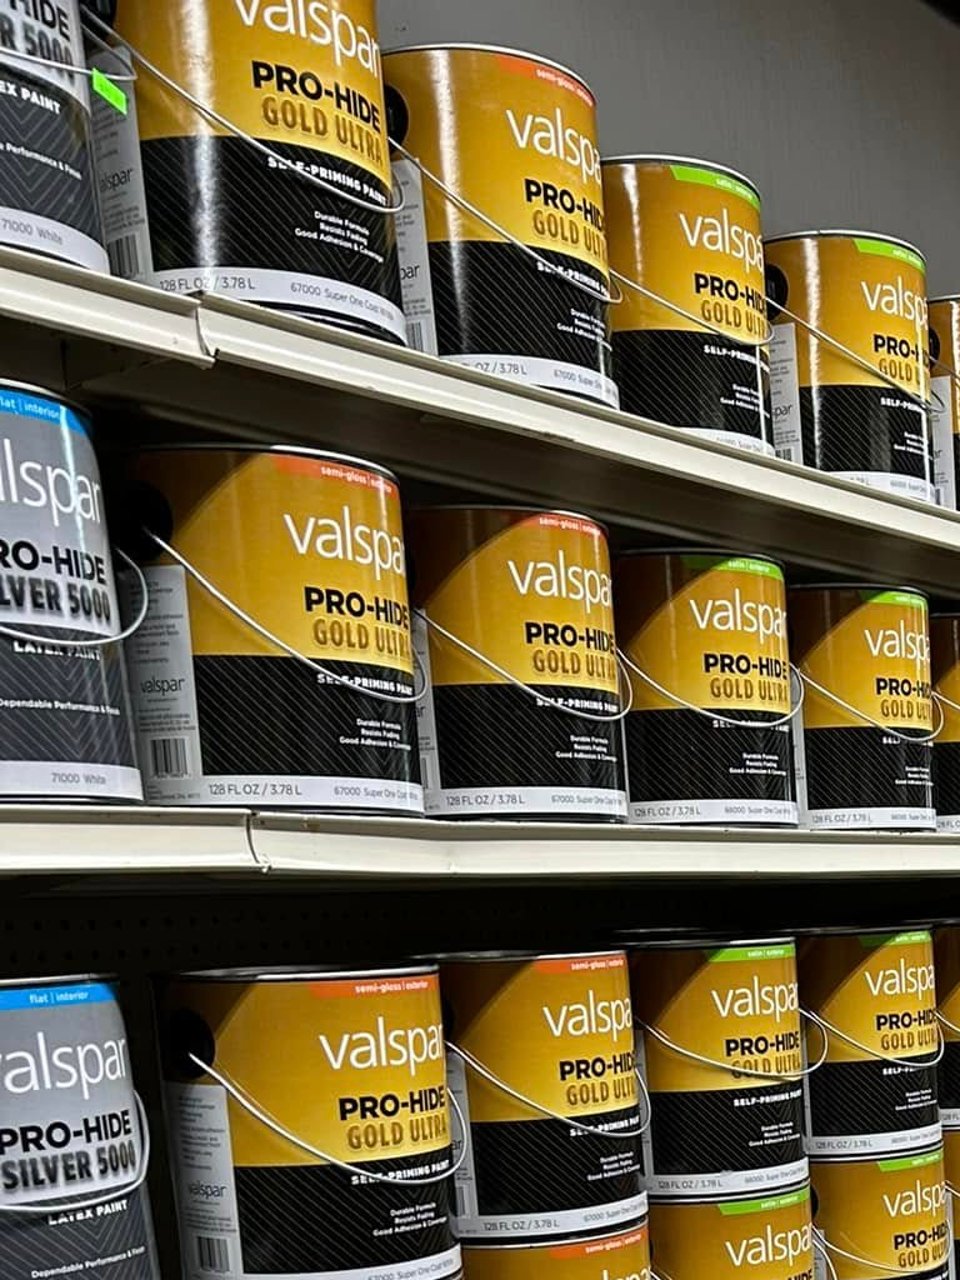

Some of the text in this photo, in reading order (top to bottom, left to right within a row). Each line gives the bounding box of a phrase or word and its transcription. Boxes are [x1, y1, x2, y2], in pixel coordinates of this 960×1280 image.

[22, 90, 61, 115] PAINT
[252, 60, 381, 133] PRO-HIDE
[262, 98, 383, 166] GOLD ULTRA
[533, 210, 579, 245] GOLD
[160, 277, 246, 291] 128 FL 3.78
[701, 301, 742, 328] GOLD
[879, 357, 913, 382] GOLD
[24, 402, 61, 420] interior
[284, 506, 403, 581] valspa
[508, 550, 612, 613] valspa
[69, 583, 111, 629] 5000
[305, 587, 409, 629] PRO-HIDE
[313, 619, 369, 649] GOLD
[534, 650, 581, 675] GOLD
[711, 678, 752, 699] GOLD
[881, 699, 914, 718] GOLD
[209, 784, 301, 796] 128 FL OZ 3.78 L
[30, 991, 89, 1004] flat interior
[355, 982, 401, 993] semi-gloss
[543, 990, 632, 1042] valspa
[881, 1033, 917, 1051] GOLD
[339, 1088, 446, 1121] PRO-HIDE
[567, 1082, 609, 1106] GOLD
[346, 1122, 403, 1150] GOLD
[3, 1140, 136, 1190] SILVER 5000
[96, 1200, 128, 1216] PAINT
[725, 1225, 812, 1268] valspa
[898, 1246, 937, 1268] GOLD
[31, 1261, 84, 1278] Dependable
